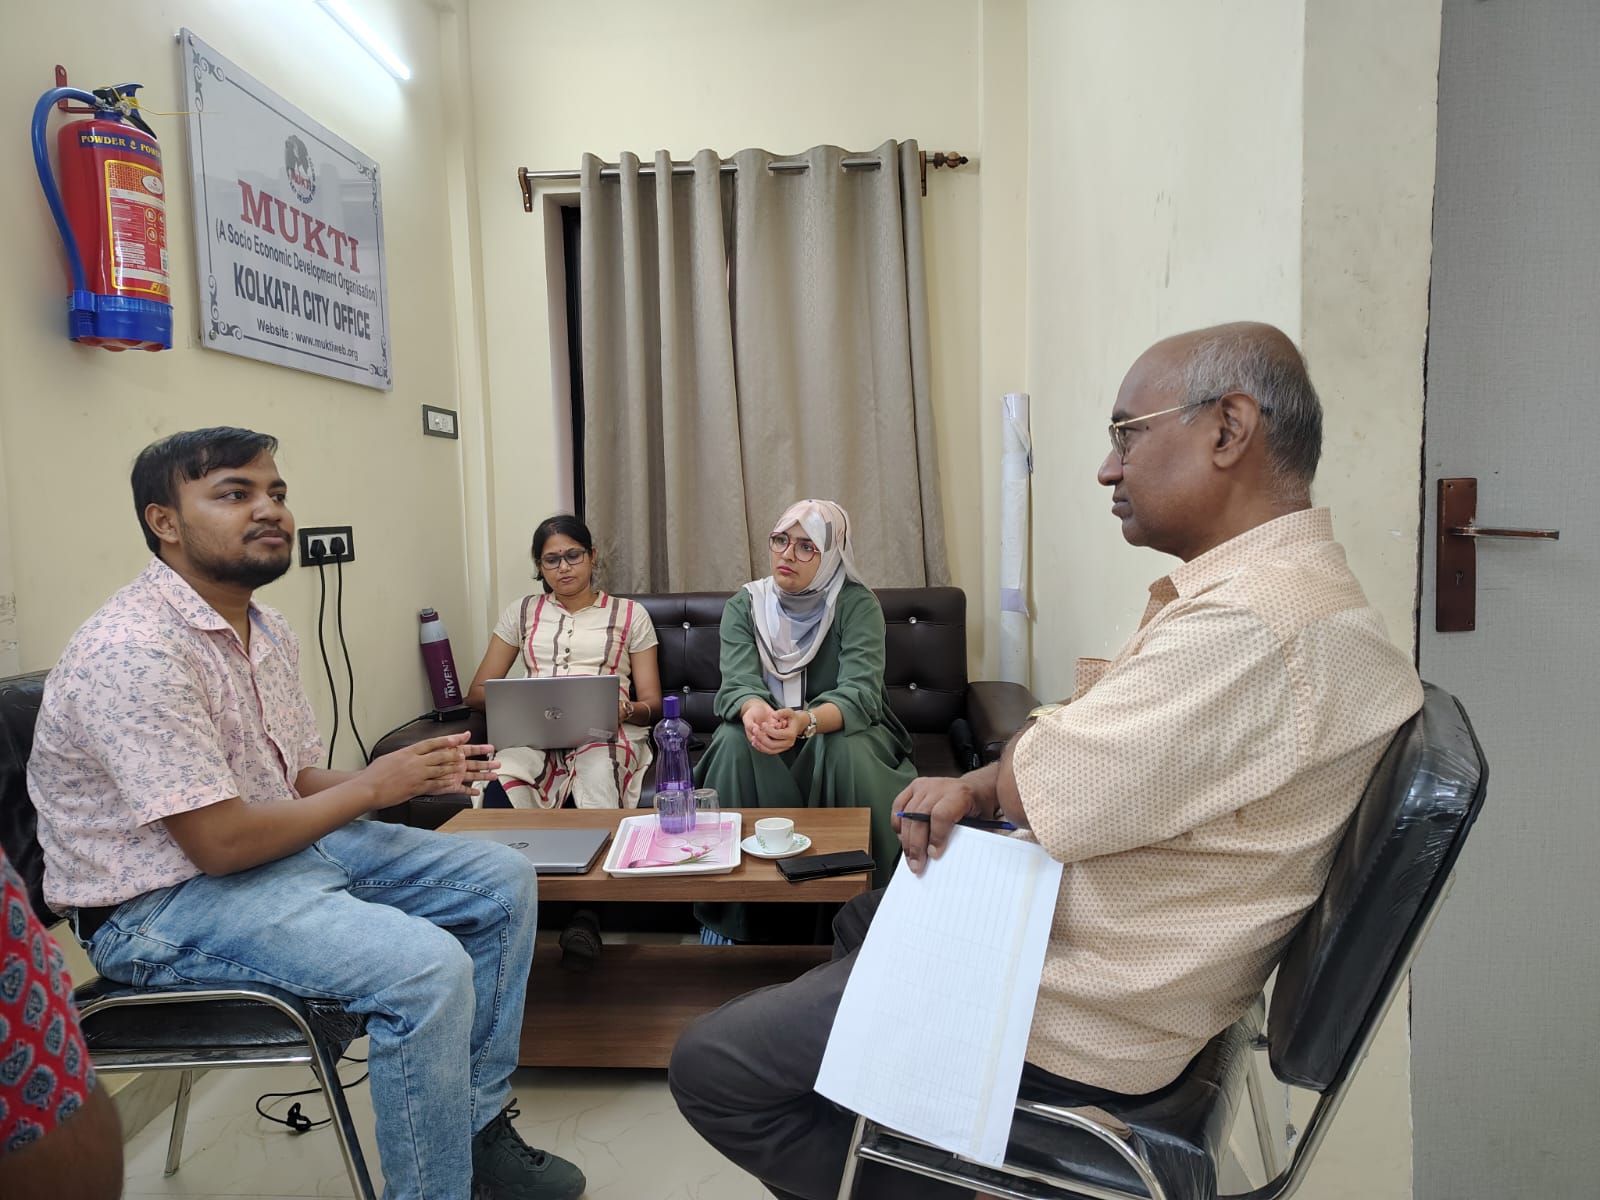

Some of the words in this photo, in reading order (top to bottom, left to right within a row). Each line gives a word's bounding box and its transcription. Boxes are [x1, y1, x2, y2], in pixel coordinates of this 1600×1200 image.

[81, 135, 126, 147] POWDER
[215, 217, 227, 244] (A
[227, 223, 252, 252] Socio
[254, 234, 292, 268] Economic
[293, 251, 337, 286] Development
[338, 271, 378, 307] Organisation)
[238, 179, 360, 273] MUKTI
[233, 262, 302, 318] KOLKATA
[303, 289, 330, 327] CITY
[333, 301, 371, 341] OFFICE
[256, 318, 289, 340] Website
[295, 332, 359, 361] www.muktiweb.org
